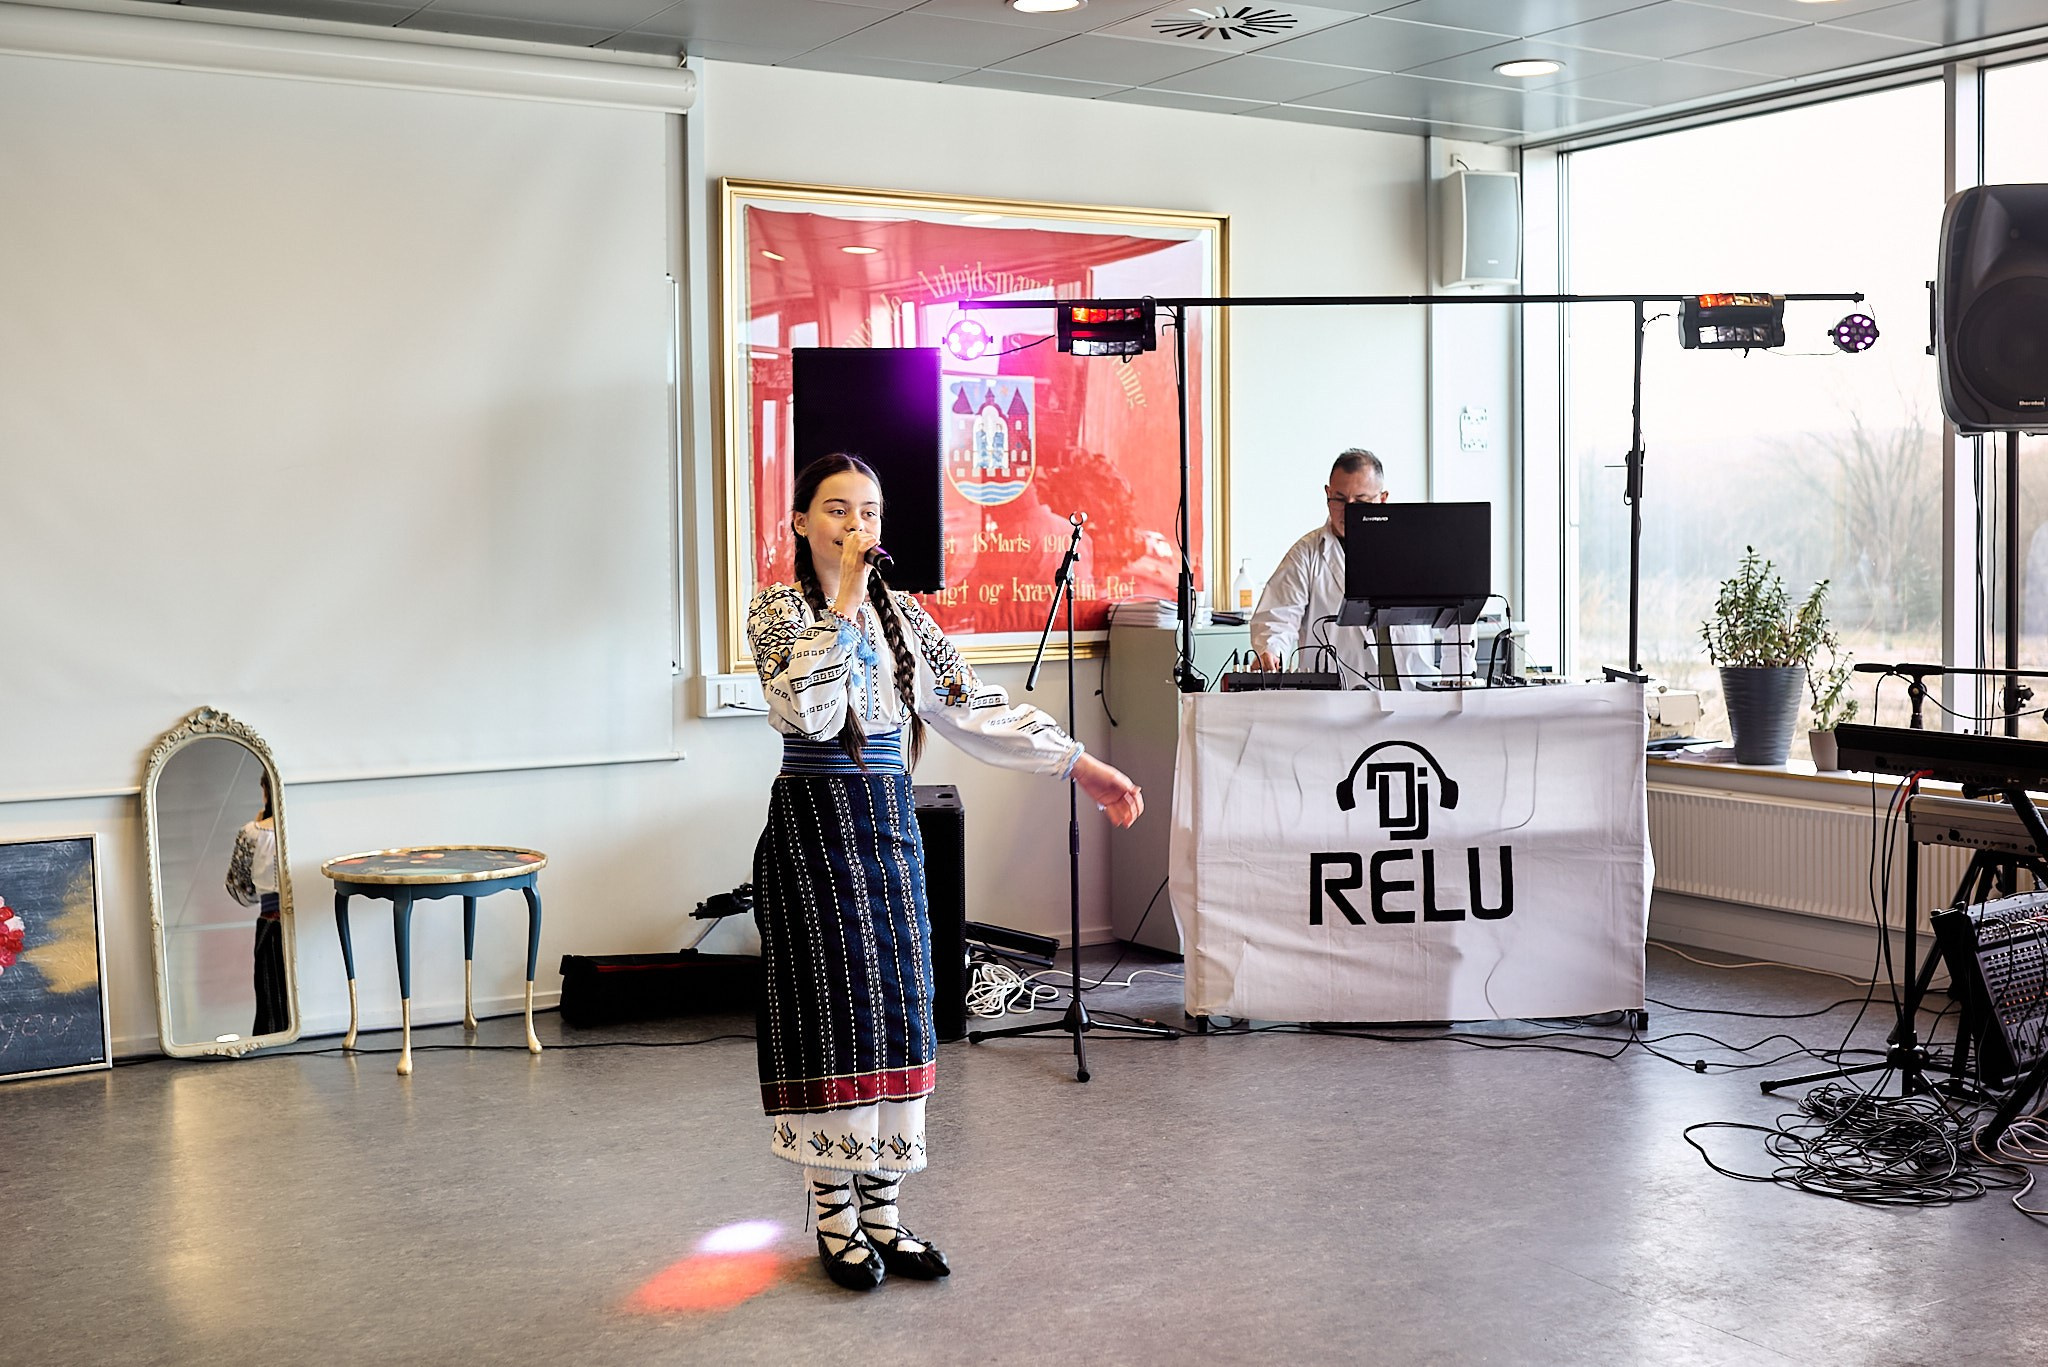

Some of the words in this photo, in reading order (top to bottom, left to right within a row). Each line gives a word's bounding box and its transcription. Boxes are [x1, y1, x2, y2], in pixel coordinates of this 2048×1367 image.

[990, 533, 1031, 553] Marts
[979, 584, 1004, 605] og
[1107, 576, 1136, 600] Ret
[1309, 845, 1514, 926] RELU
